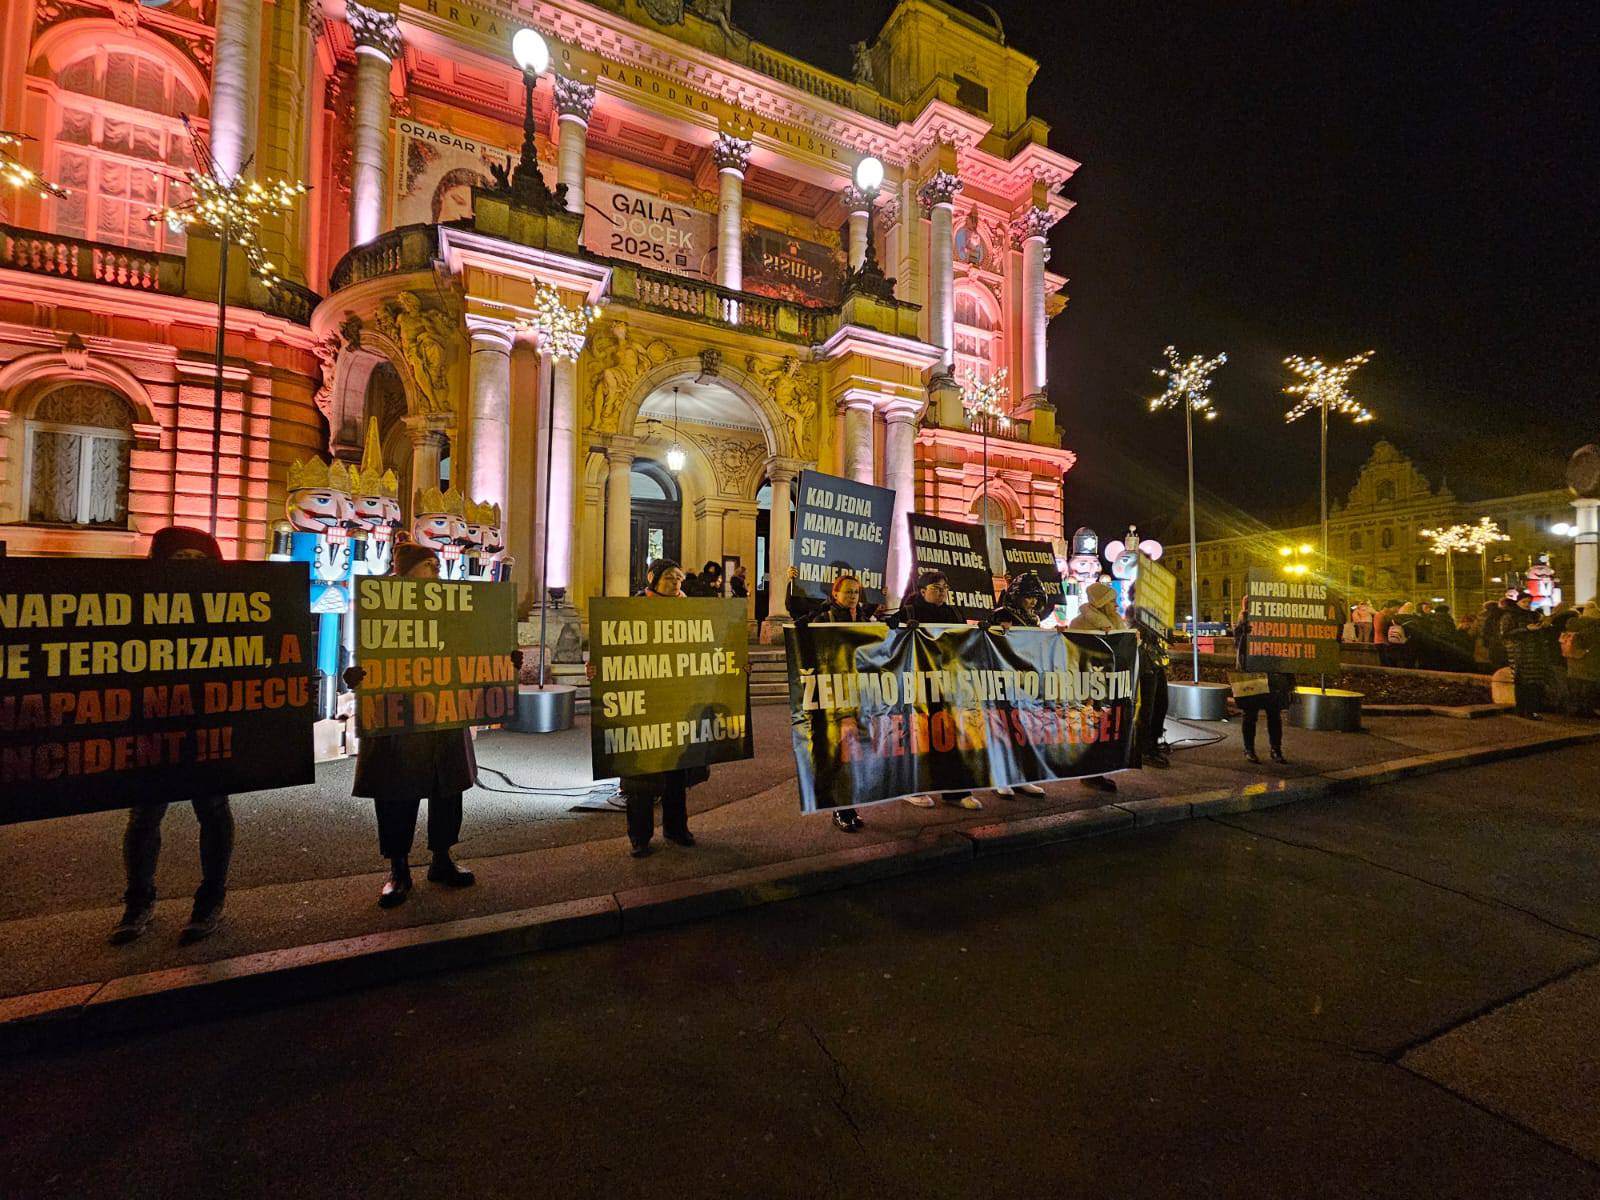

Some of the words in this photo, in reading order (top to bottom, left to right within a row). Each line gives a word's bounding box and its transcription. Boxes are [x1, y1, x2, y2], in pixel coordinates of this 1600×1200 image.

[427, 0, 570, 61] HRVAO
[601, 62, 709, 111] NARODNO
[400, 123, 476, 153] ORASAR
[612, 193, 675, 226] GALA
[611, 233, 670, 264] 2025.
[806, 487, 834, 508] KAD
[835, 494, 872, 517] JEDNA
[803, 512, 843, 536] MAMA
[846, 521, 883, 545] PLAČE,
[913, 526, 937, 543] KAD
[938, 529, 971, 549] JEDNA
[801, 538, 826, 558] SVE
[916, 546, 952, 566] MAMA
[952, 551, 986, 571] PLAČE,
[1005, 548, 1055, 565] UČITELJICA
[800, 562, 838, 584] MAME
[360, 579, 420, 611] SVE
[424, 584, 474, 612] STE
[956, 590, 994, 609] PLAČU!
[1251, 581, 1288, 598] NAPAD
[1289, 583, 1305, 598] NA
[1305, 585, 1327, 600] VAS
[0, 592, 132, 629] NAPAD
[143, 592, 195, 625] NA
[201, 590, 272, 623] VAS
[1249, 601, 1262, 616] JE
[1263, 602, 1327, 621] TERORIZAM,
[361, 619, 445, 652] UZELI,
[601, 620, 648, 646] KAD
[652, 619, 715, 644] JEDNA
[1250, 621, 1287, 637] NAPAD
[1289, 623, 1305, 638] NA
[0, 644, 30, 680] E
[41, 635, 272, 678] TERORIZAM,
[279, 632, 303, 665] A
[602, 654, 673, 682] MAMA
[676, 648, 740, 677] PLAČE,
[1248, 641, 1302, 658] INCIDENT
[361, 656, 452, 690] DJECU
[457, 655, 515, 684] VAM
[143, 683, 195, 719] NA
[203, 675, 310, 715] DJECU
[602, 690, 647, 718] SVE
[799, 668, 899, 711] ŽELIMO
[361, 693, 405, 730] NE
[413, 686, 515, 726] DAMO!
[604, 722, 673, 754] MAME
[676, 713, 746, 746] PLAČU!
[2, 730, 187, 783] NCIDENT
